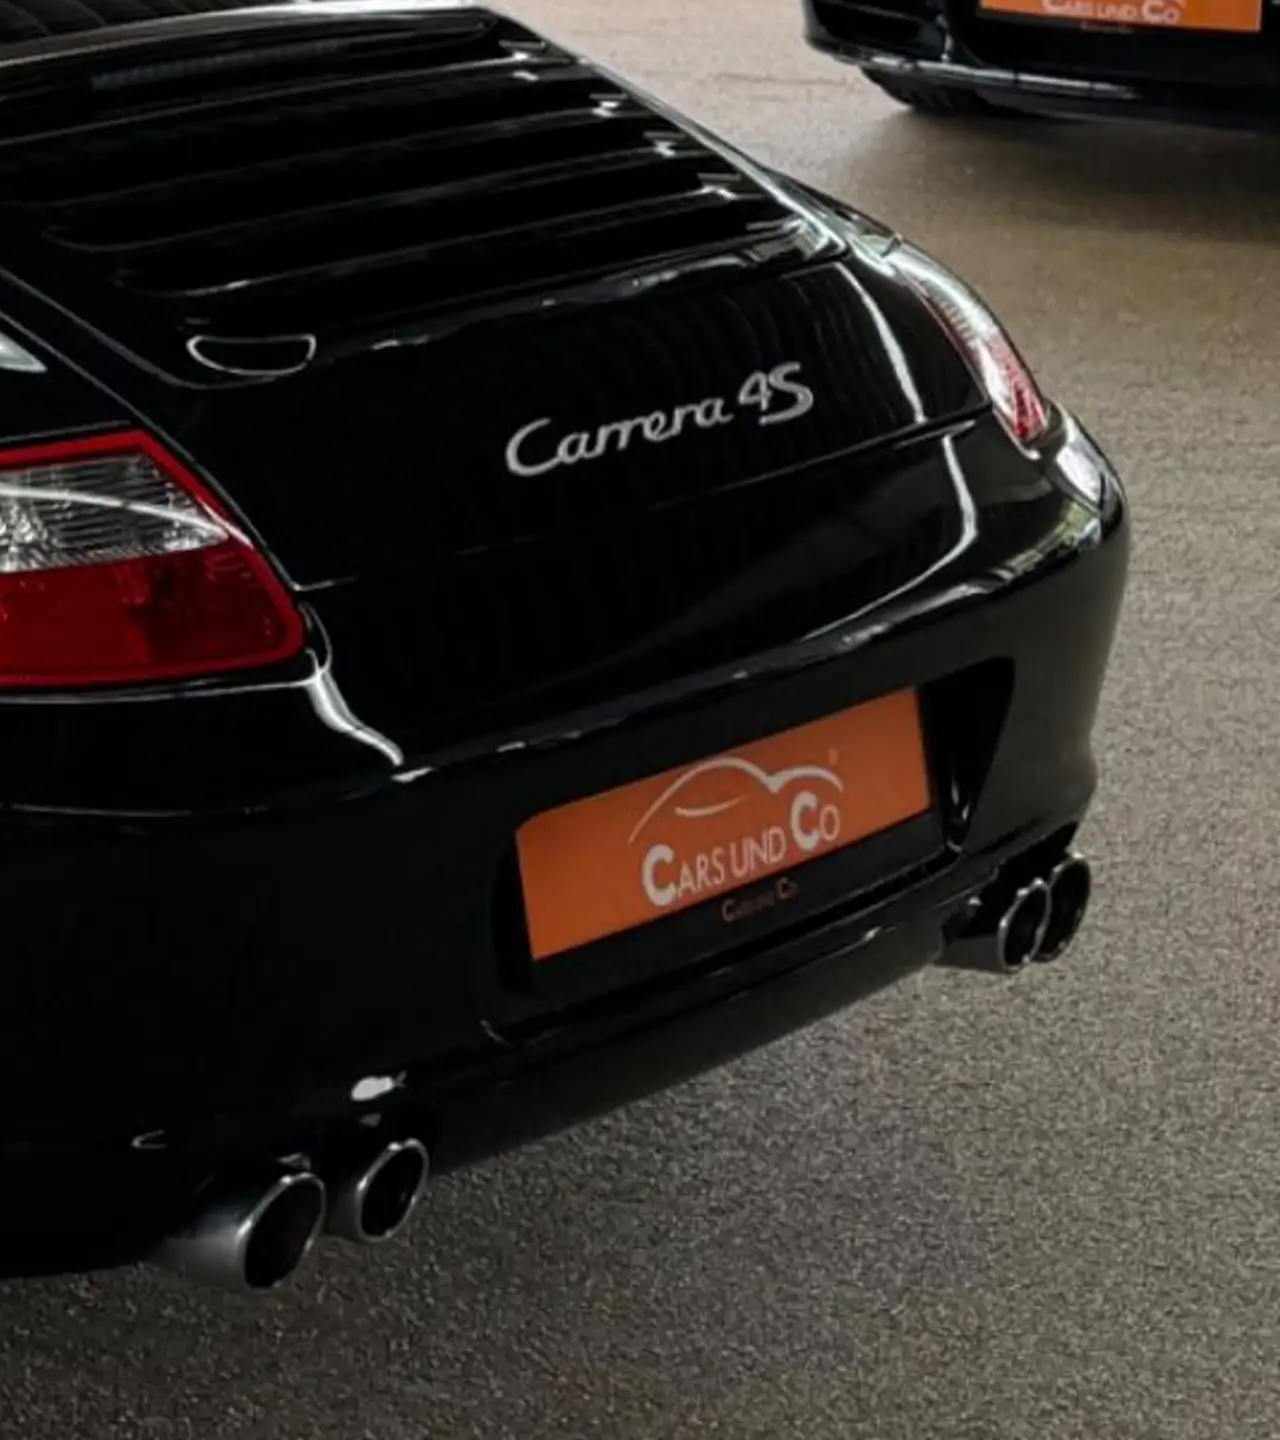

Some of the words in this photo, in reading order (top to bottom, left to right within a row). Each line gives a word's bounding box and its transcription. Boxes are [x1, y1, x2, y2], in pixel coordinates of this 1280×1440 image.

[505, 397, 734, 476] Carrera
[738, 362, 813, 425] 4S
[642, 843, 725, 906] CARS
[729, 825, 787, 878] UND
[790, 791, 840, 851] CO
